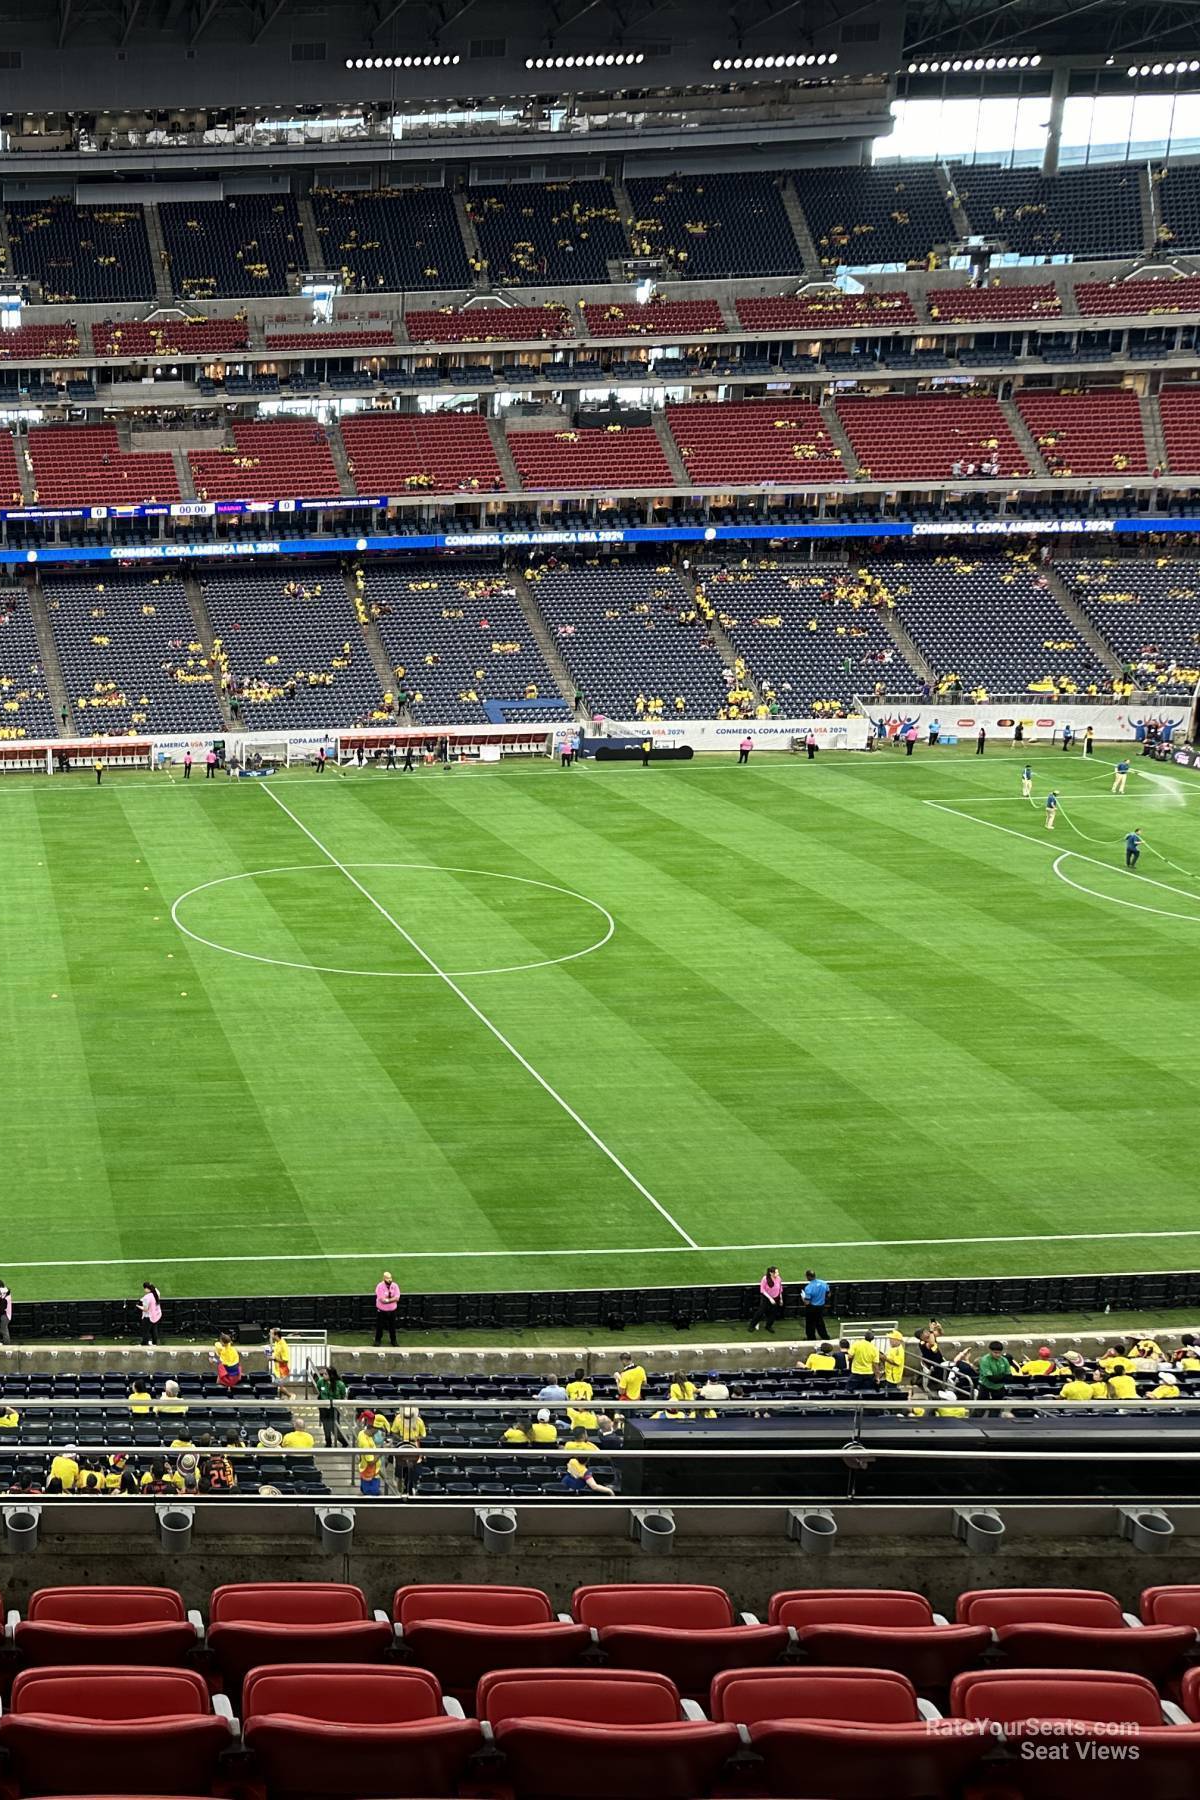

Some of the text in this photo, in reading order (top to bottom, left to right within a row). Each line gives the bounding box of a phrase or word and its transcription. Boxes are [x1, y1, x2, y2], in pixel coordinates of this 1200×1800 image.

[283, 502, 290, 510] 0
[96, 509, 103, 517] 0
[912, 520, 1116, 535] CONMEBOL COPA AMERICA USA 2024
[444, 530, 625, 546] CONMEBOL COPA AMERICA USA 2024
[110, 542, 280, 558] CONMEBOL COPA AMERICA USA 2024
[159, 741, 189, 749] AMERICA
[191, 740, 203, 748] USA
[288, 737, 307, 745] COPA
